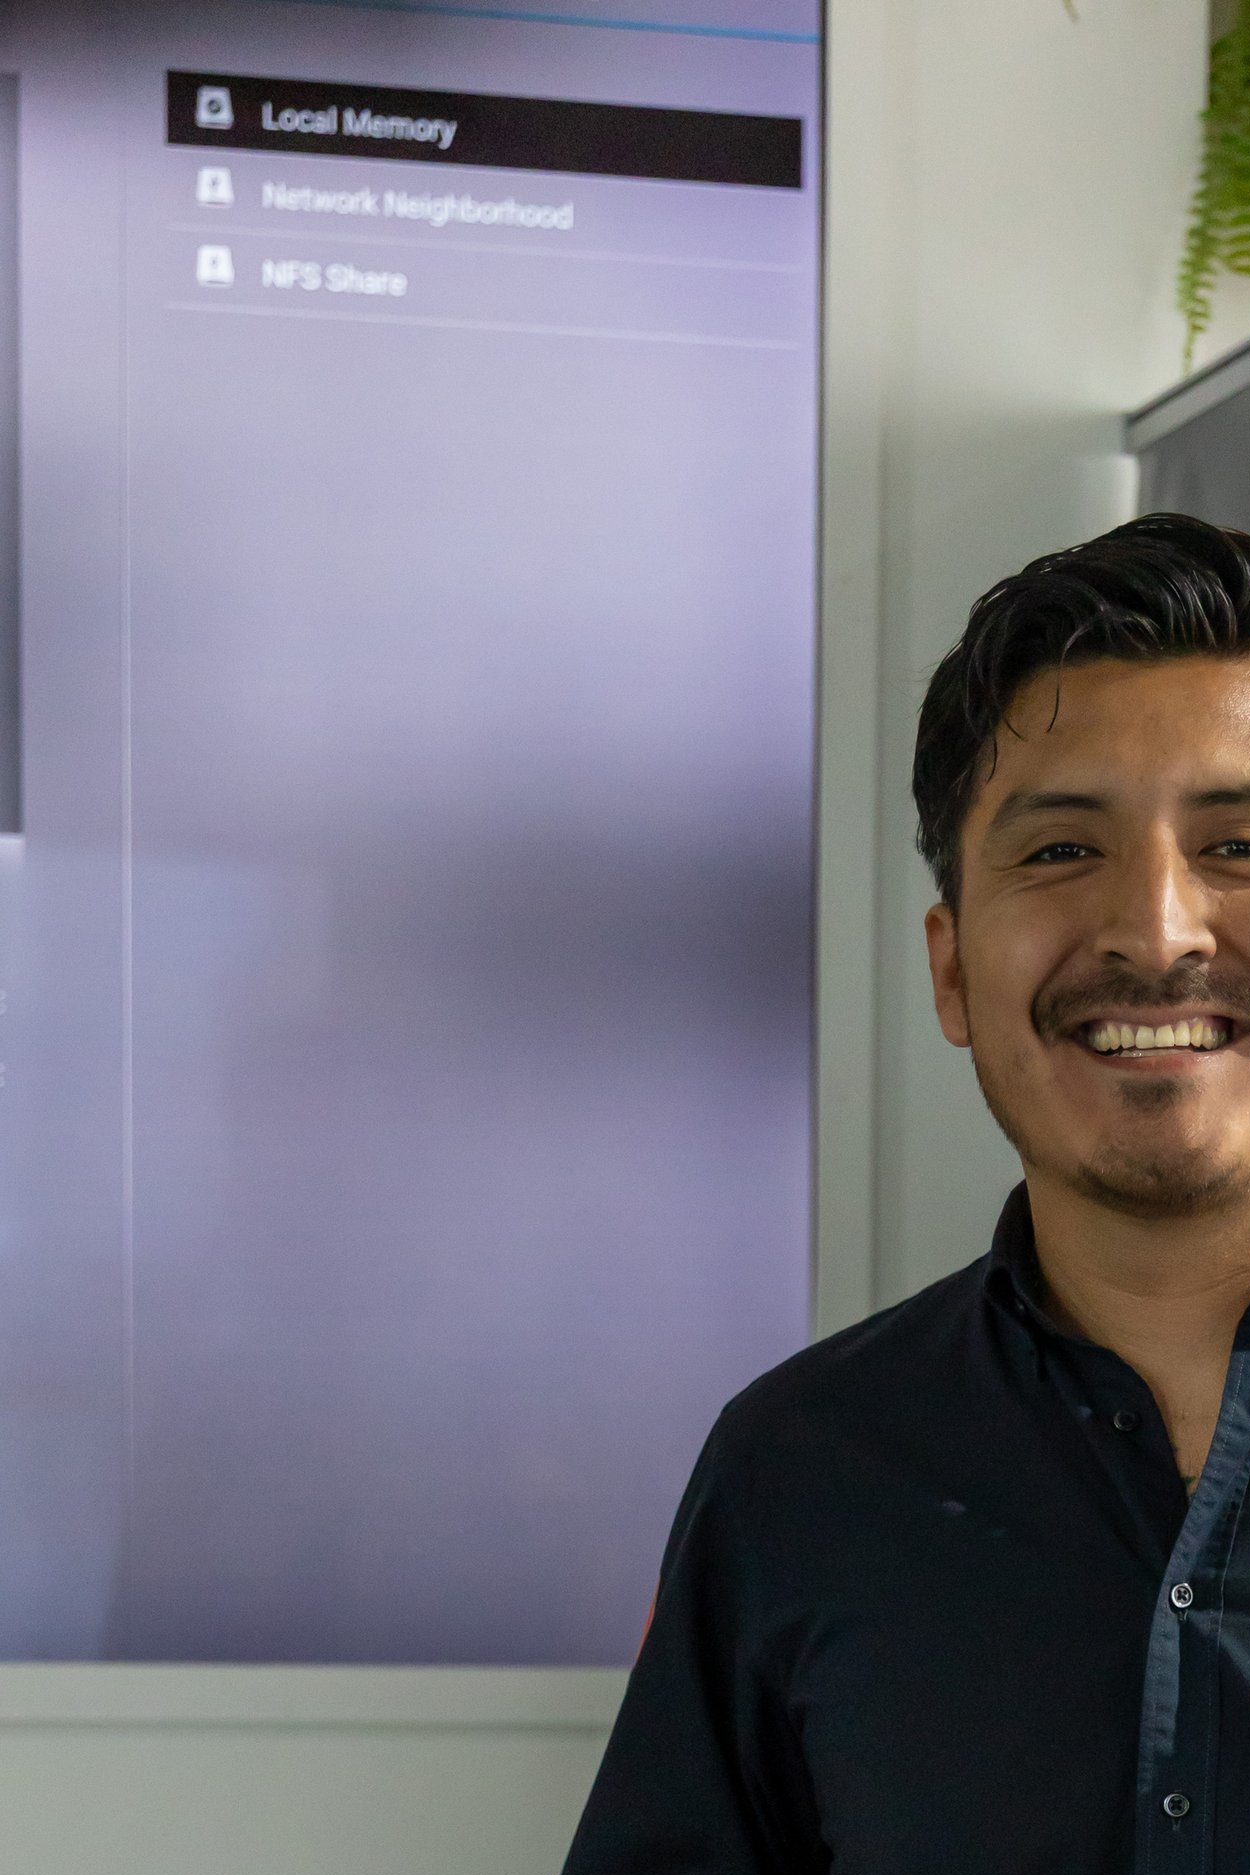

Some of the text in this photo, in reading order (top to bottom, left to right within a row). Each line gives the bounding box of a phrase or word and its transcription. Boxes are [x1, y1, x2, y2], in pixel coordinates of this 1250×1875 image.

[261, 100, 457, 150] Local Memory
[261, 181, 574, 230] Network Neighborhood
[261, 259, 408, 297] NFS Share
